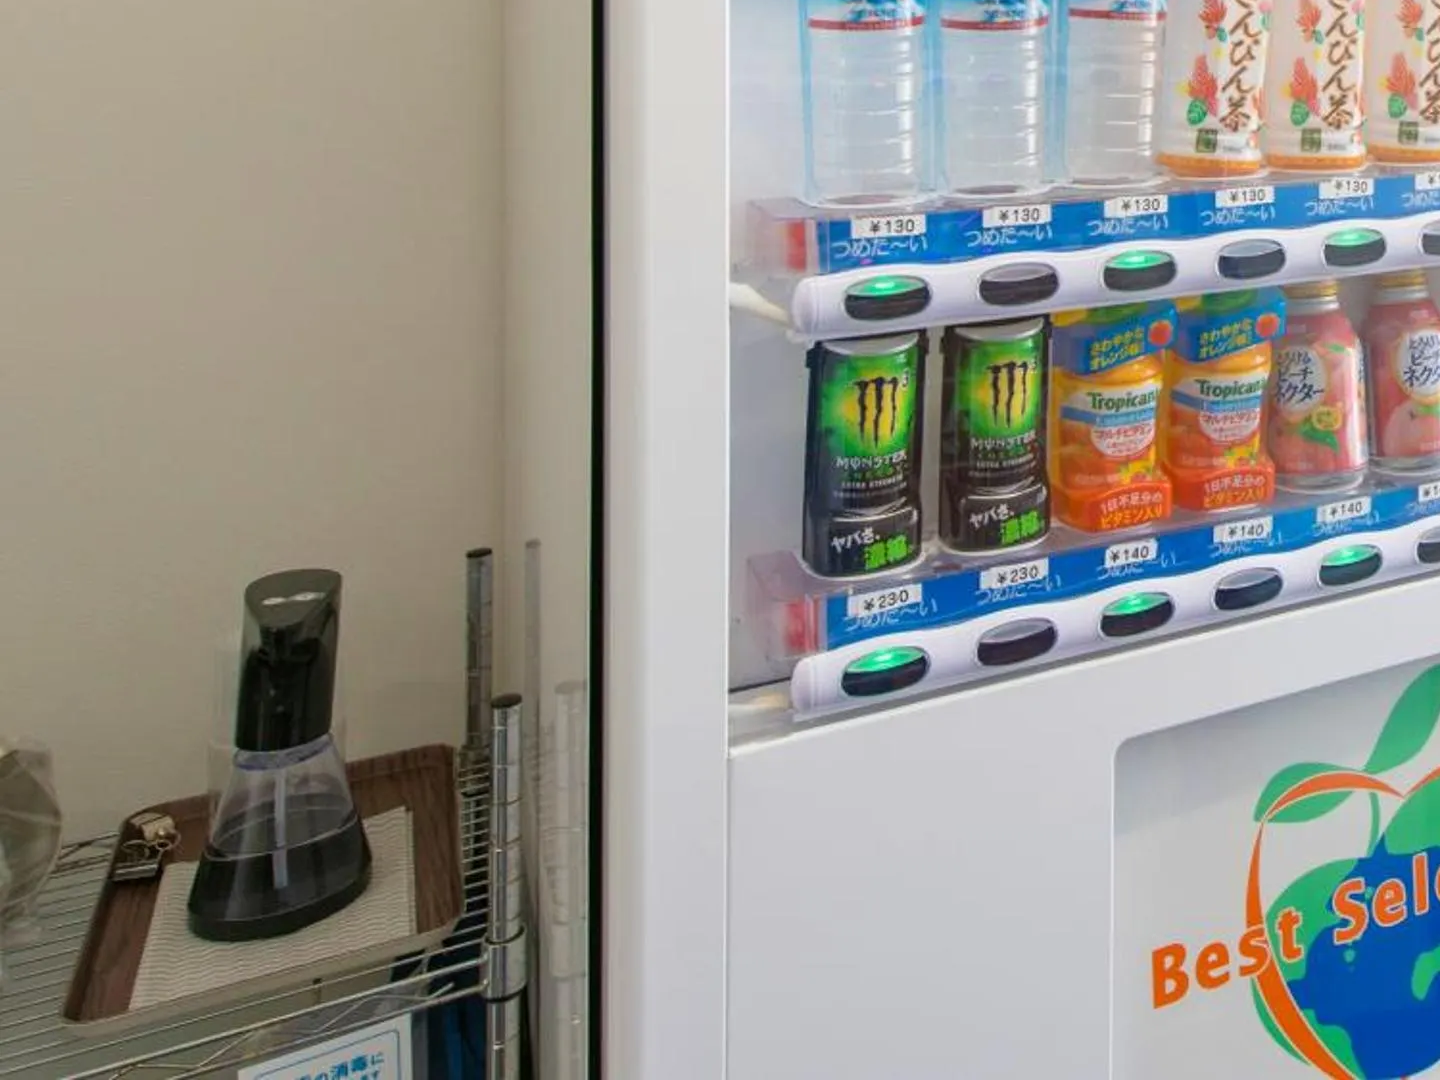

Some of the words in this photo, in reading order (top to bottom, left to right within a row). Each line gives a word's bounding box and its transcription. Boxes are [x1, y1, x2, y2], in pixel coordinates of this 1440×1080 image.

[1334, 179, 1368, 196] ¥130
[1121, 197, 1161, 213] ¥130
[1228, 189, 1267, 205] ¥130
[999, 207, 1041, 223] ¥130
[869, 219, 916, 234] ¥130
[970, 430, 1037, 450] MONSTER
[835, 450, 908, 470] MONSTER
[1328, 500, 1364, 517] ¥140
[1227, 523, 1265, 539] ¥140
[1108, 545, 1150, 563] ¥140
[997, 564, 1040, 584] ¥230
[863, 589, 910, 612] ¥230
[1151, 906, 1303, 1010] Best
